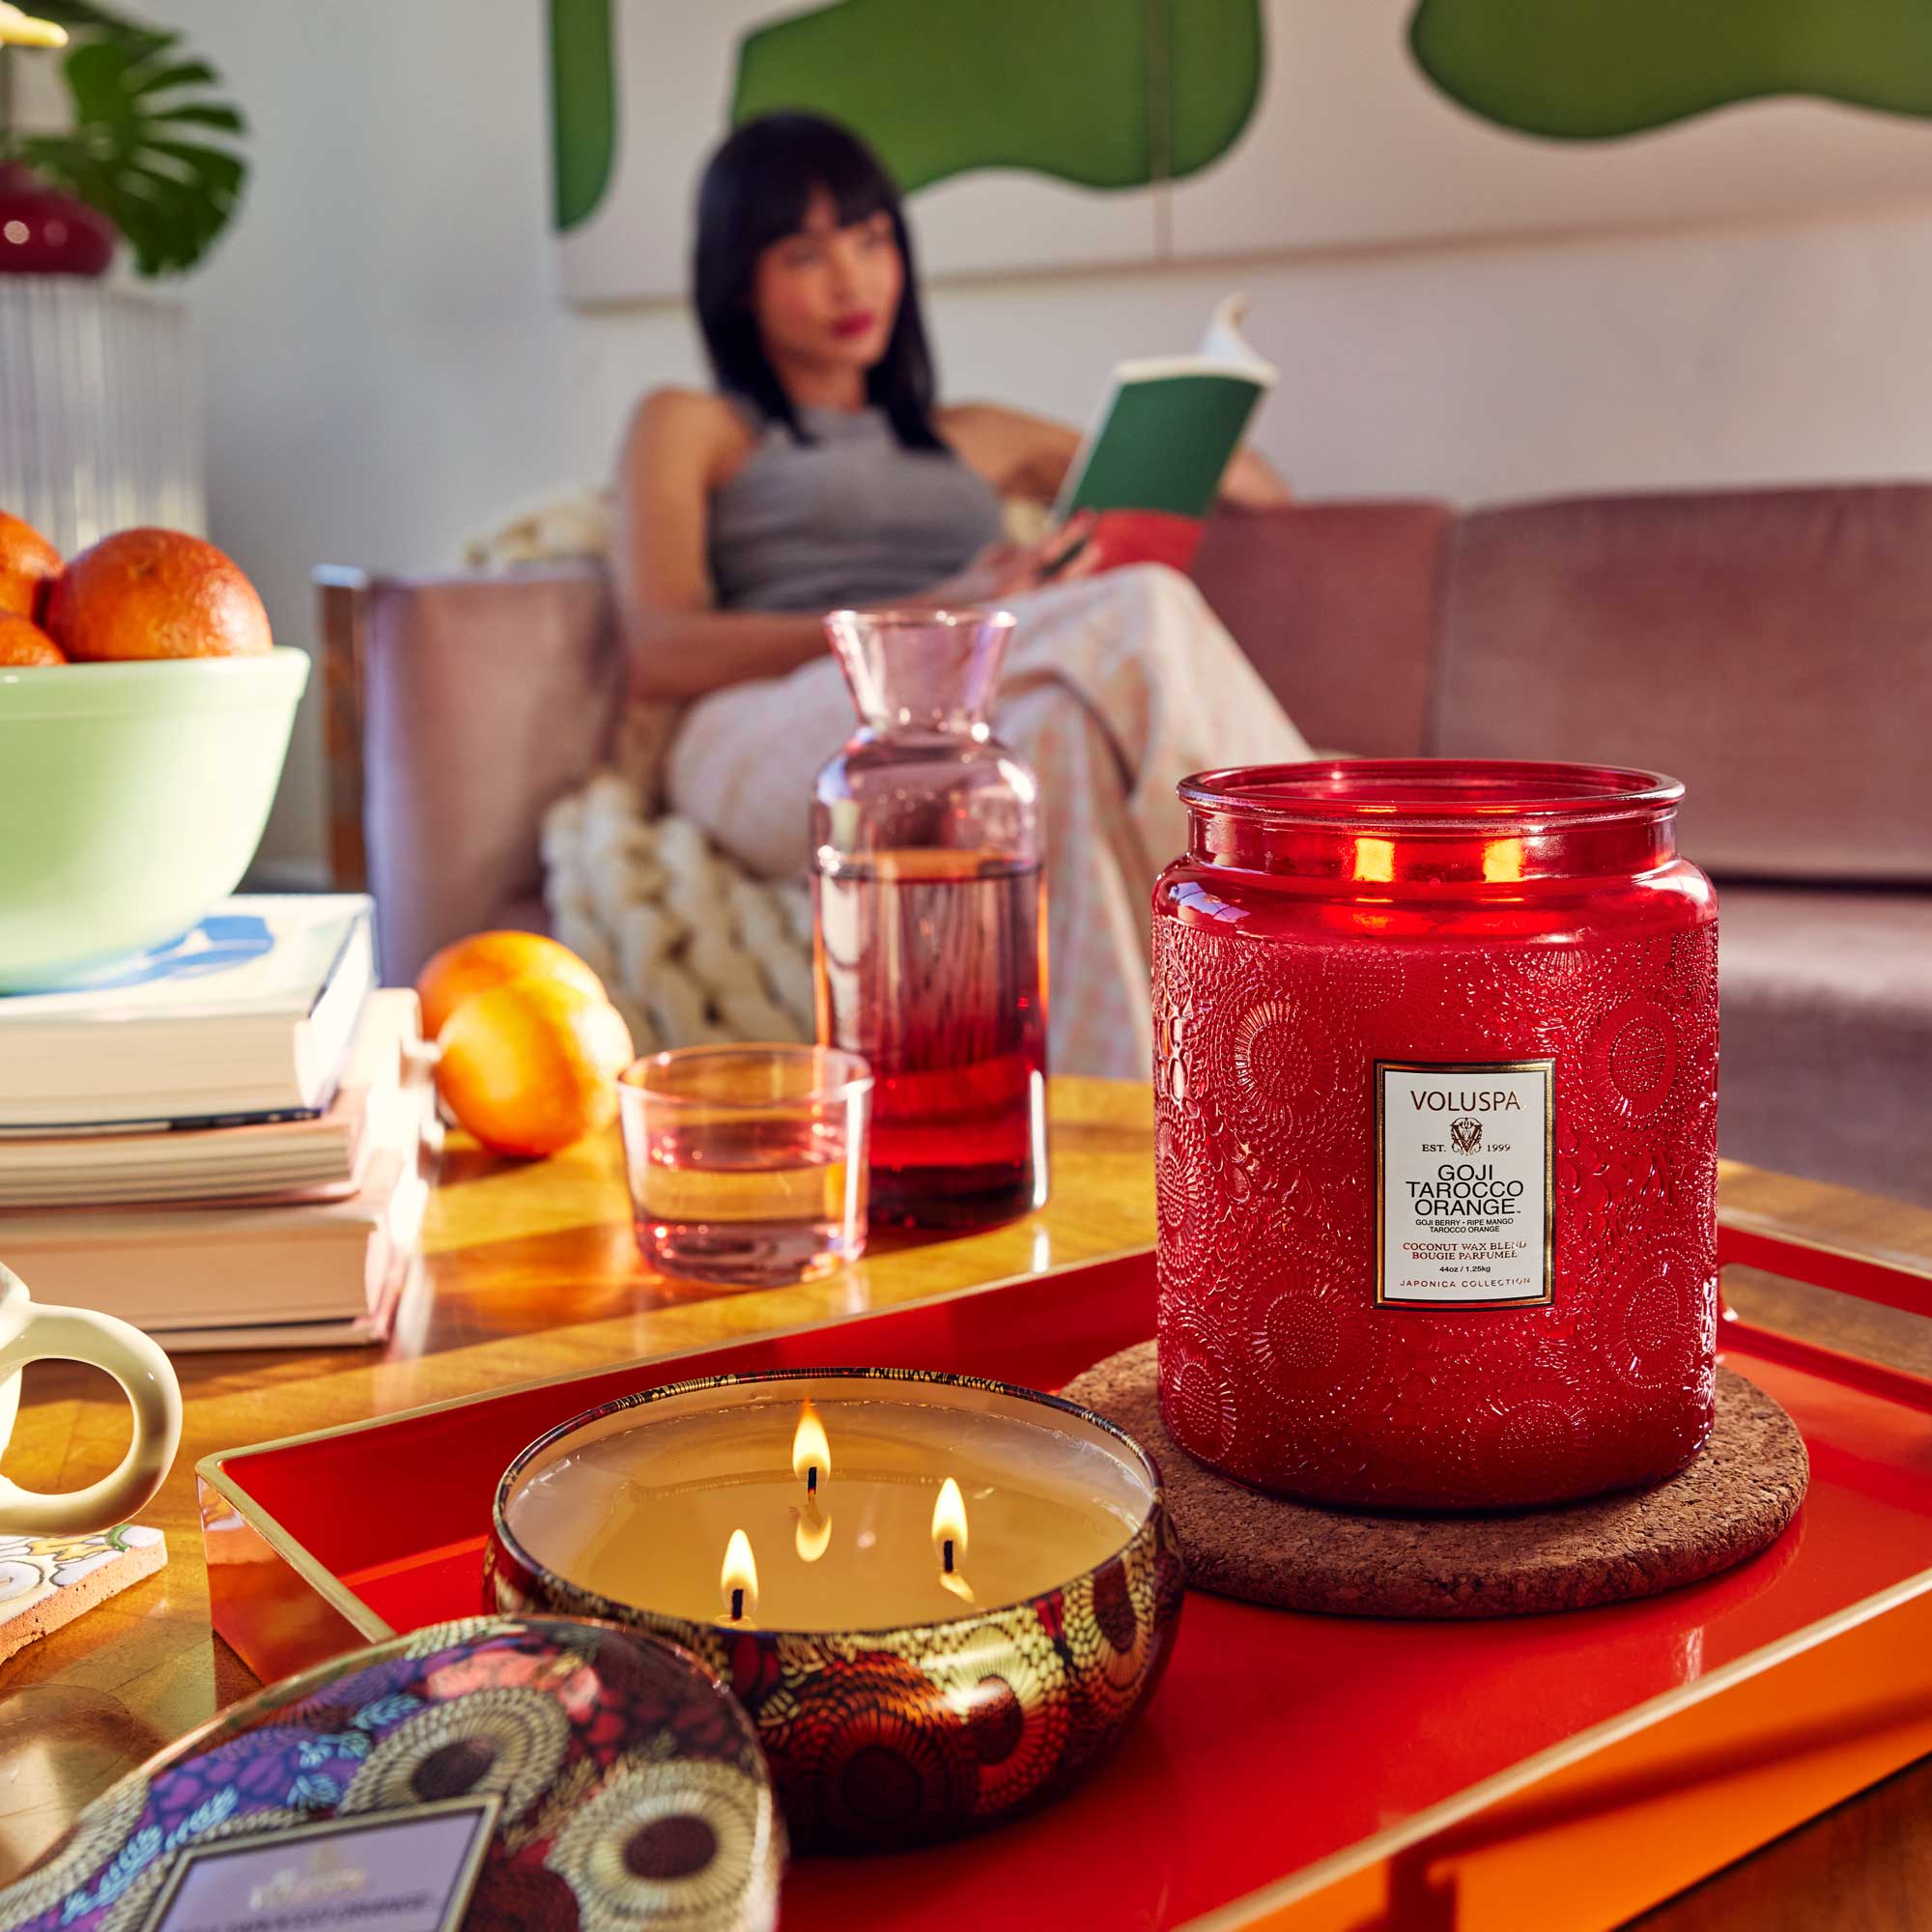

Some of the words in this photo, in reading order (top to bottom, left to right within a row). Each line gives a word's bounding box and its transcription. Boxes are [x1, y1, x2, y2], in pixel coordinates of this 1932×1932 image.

[1410, 1091, 1521, 1112] VOLUSPA
[1421, 1144, 1447, 1152] EST.
[1486, 1144, 1511, 1152] 1999
[1437, 1164, 1493, 1181] GOJI
[1406, 1180, 1524, 1199] TAROCCO
[1486, 1217, 1514, 1226] MANGO
[1467, 1225, 1500, 1234] ORANGE
[1403, 1242, 1458, 1252] COCONUT
[1461, 1242, 1488, 1251] WAX
[1490, 1240, 1527, 1251] BLEND
[1412, 1251, 1456, 1261] BOUGIE
[1400, 1279, 1457, 1288] JAPONICA
[1461, 1277, 1531, 1288] COLLECTION
